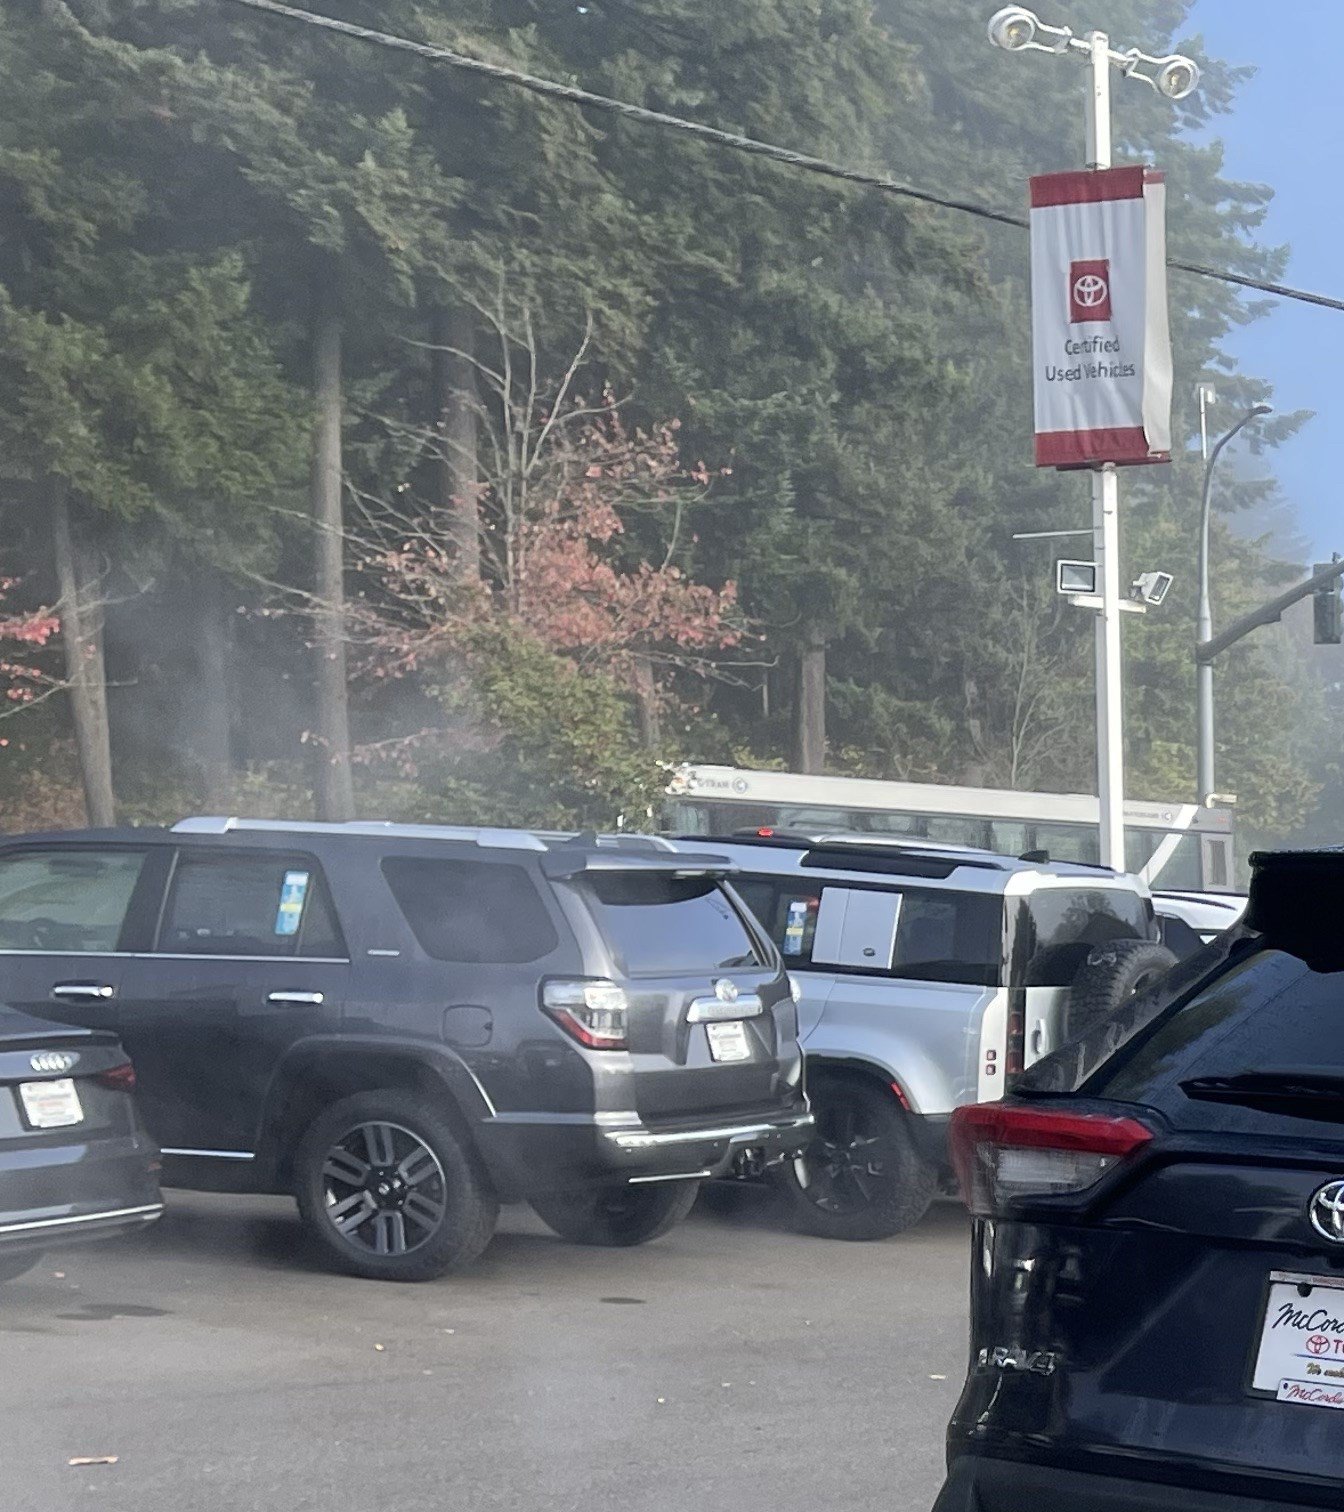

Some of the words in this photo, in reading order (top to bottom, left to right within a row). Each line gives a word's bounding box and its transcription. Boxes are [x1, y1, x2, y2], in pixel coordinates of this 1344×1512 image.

[1064, 335, 1120, 356] Certified
[1045, 363, 1081, 382] Used
[1082, 362, 1135, 381] Vehicles
